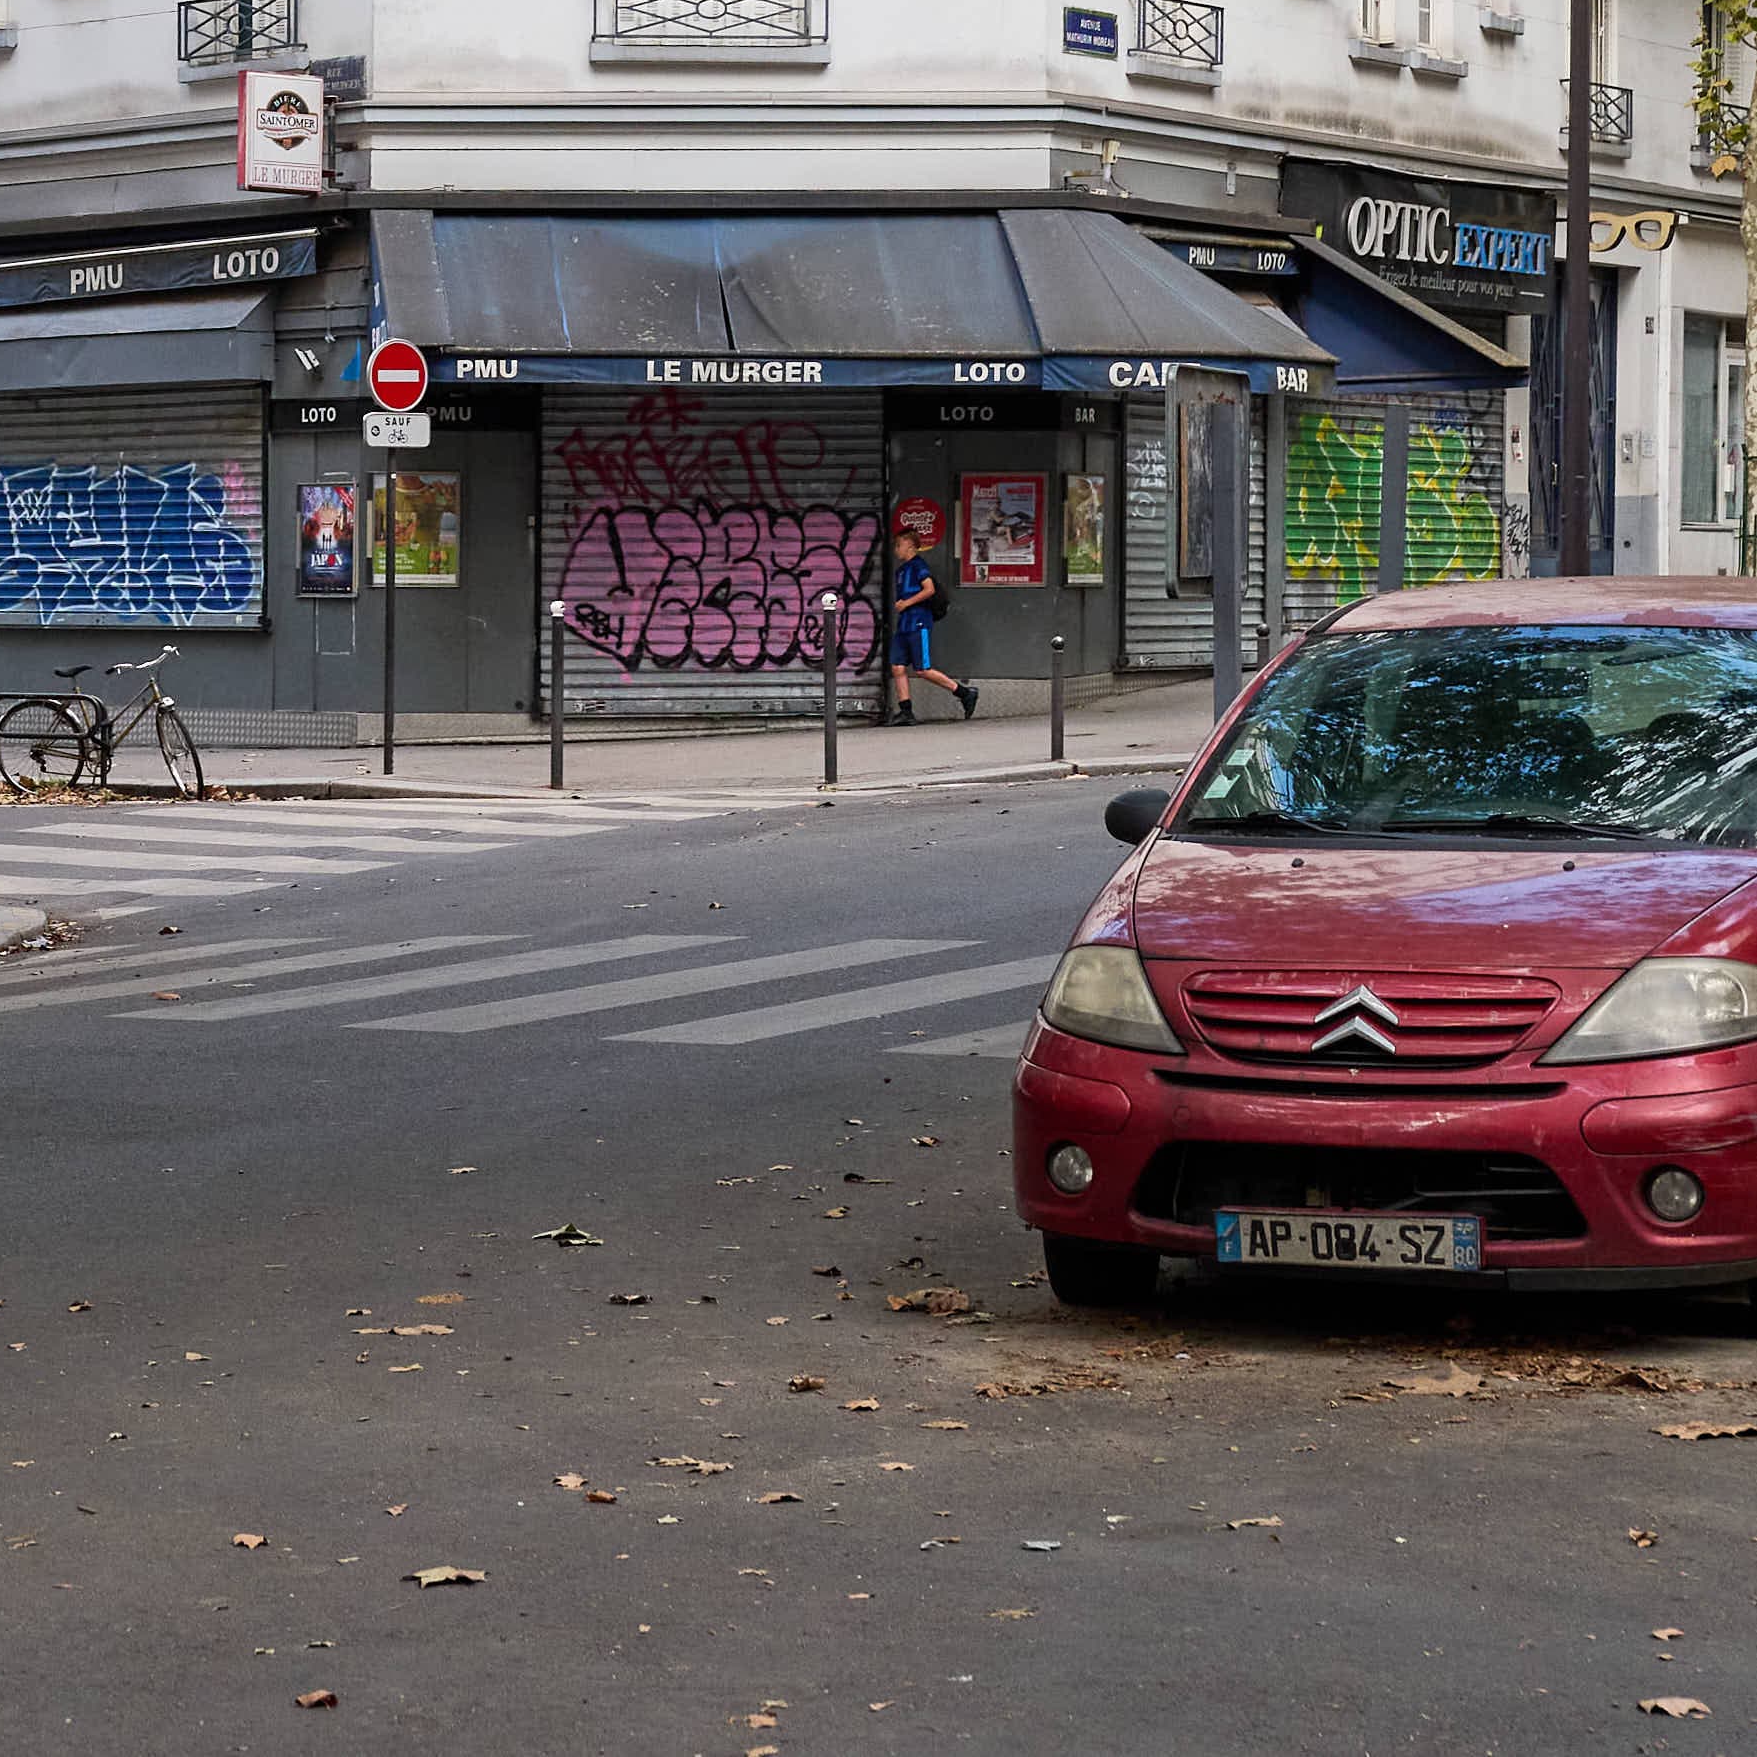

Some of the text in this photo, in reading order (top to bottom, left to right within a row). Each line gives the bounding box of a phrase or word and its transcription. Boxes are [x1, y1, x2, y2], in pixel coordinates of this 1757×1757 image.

[254, 167, 320, 185] LE MURGER
[1348, 196, 1550, 275] OPTIC EXPERT
[212, 246, 280, 281] LOTO
[1188, 246, 1215, 266] PMU
[1257, 252, 1286, 271] LOTO
[69, 263, 123, 294] PMU
[456, 359, 519, 379] PMU
[646, 360, 823, 384] LE MURGER
[953, 362, 1026, 383] LOTO
[1276, 365, 1309, 393] BAR
[301, 406, 337, 424] LOTO
[385, 416, 411, 426] SAUF
[426, 406, 473, 422] PMU
[940, 406, 994, 422] LOTO
[1075, 407, 1095, 423] BAR
[1454, 1245, 1476, 1266] 80
